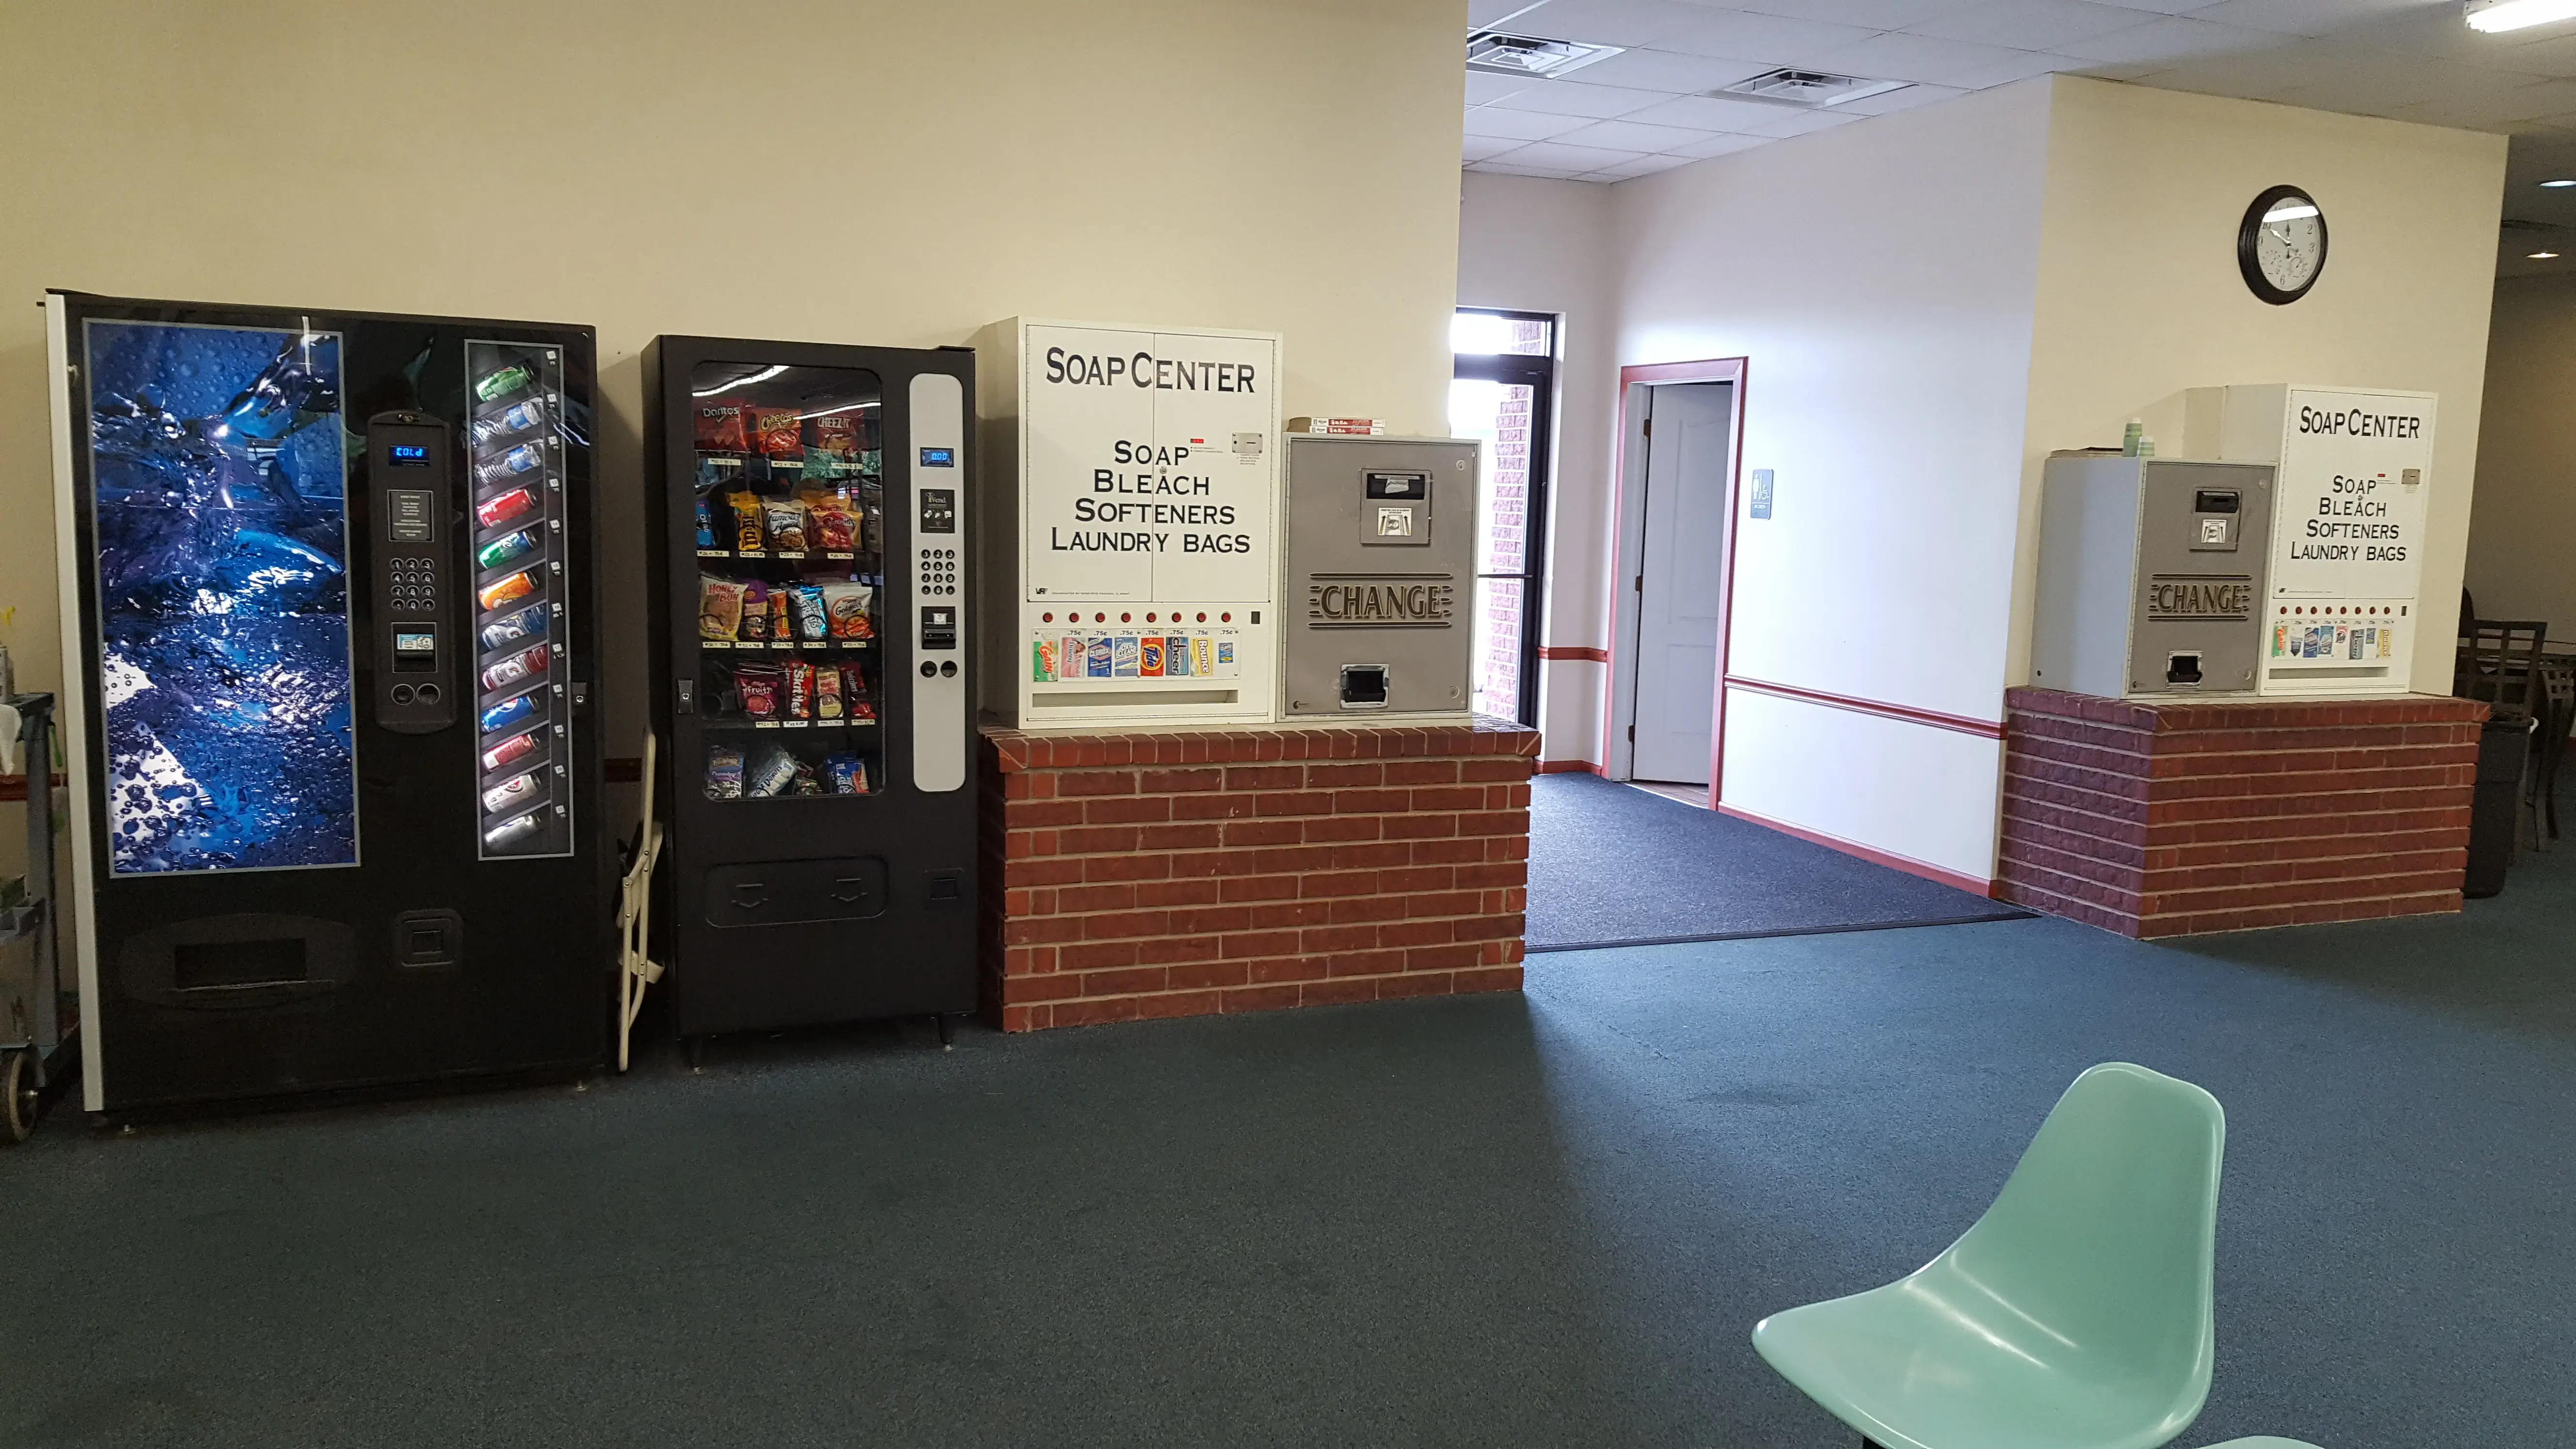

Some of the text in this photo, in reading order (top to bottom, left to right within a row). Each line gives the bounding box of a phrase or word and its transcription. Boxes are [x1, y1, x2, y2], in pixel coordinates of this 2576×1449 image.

[2307, 224, 2313, 234] 2
[2309, 242, 2315, 253] 3
[2280, 274, 2285, 285] 6
[703, 406, 740, 418] Doritos
[760, 412, 794, 431] Cheetos
[1114, 440, 1190, 466] SOAP
[1093, 468, 1210, 496] BLEACH
[2332, 475, 2377, 495] SOAP
[1075, 498, 1236, 525] SOFTENERS
[2318, 497, 2387, 517] BLEACH
[2305, 518, 2399, 539] SOFTENERS
[1051, 527, 1251, 553] LAUNDRY BAGS
[2290, 541, 2407, 562] LAUNDRY BAGS
[708, 583, 738, 594] HONEY
[718, 593, 740, 603] BUN
[2158, 584, 2241, 612] CHANGE
[1320, 585, 1441, 617] CHANGE
[1089, 647, 1110, 657] CLOROX
[1143, 646, 1159, 668] Tide
[1172, 637, 1187, 675] cheer
[1198, 639, 1210, 673] Bounce
[790, 669, 805, 715] Skittles
[763, 766, 783, 787] DONUTS
